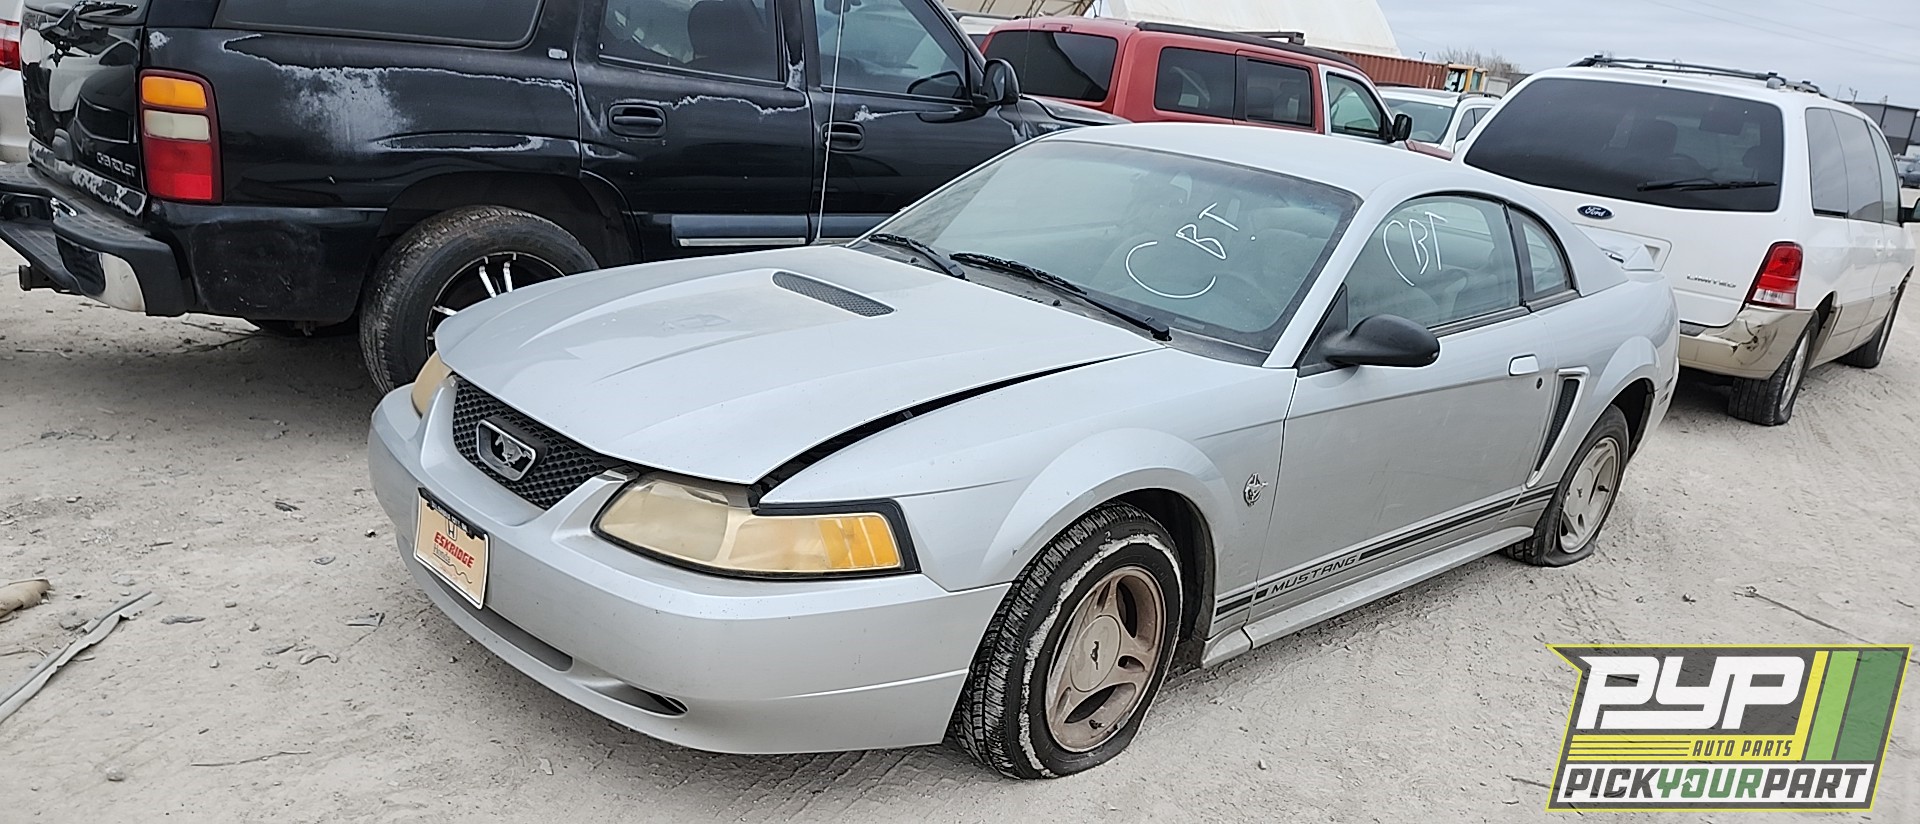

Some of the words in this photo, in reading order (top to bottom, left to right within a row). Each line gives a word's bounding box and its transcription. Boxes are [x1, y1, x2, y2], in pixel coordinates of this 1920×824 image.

[1584, 205, 1606, 217] Ford
[1383, 211, 1448, 287] CBT
[433, 531, 475, 568] ESKRIDGE
[1271, 555, 1357, 594] MUSTANG
